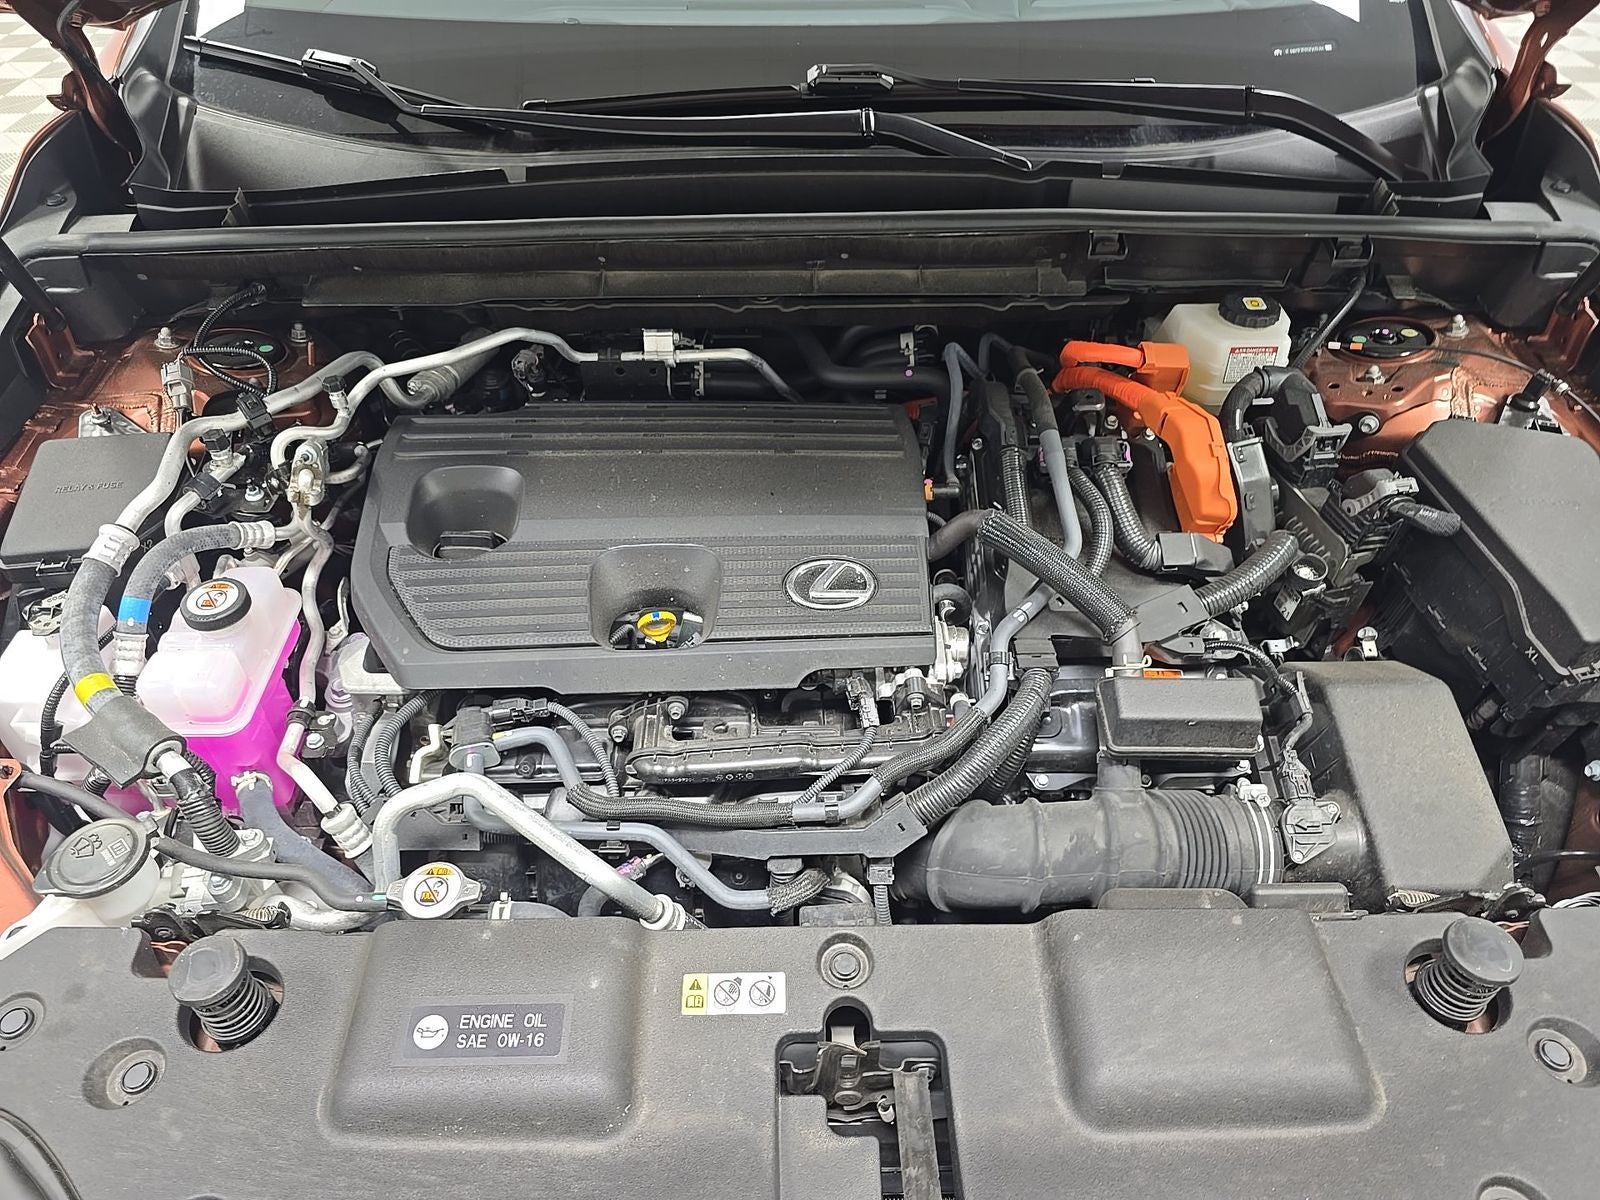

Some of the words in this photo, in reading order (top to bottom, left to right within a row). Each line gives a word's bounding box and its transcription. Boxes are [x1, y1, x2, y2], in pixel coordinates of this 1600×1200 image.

[55, 482, 88, 494] RELAY
[97, 481, 124, 490] FUSE
[459, 1013, 515, 1029] ENGINE
[524, 1012, 548, 1028] OIL
[456, 1033, 488, 1049] SAE
